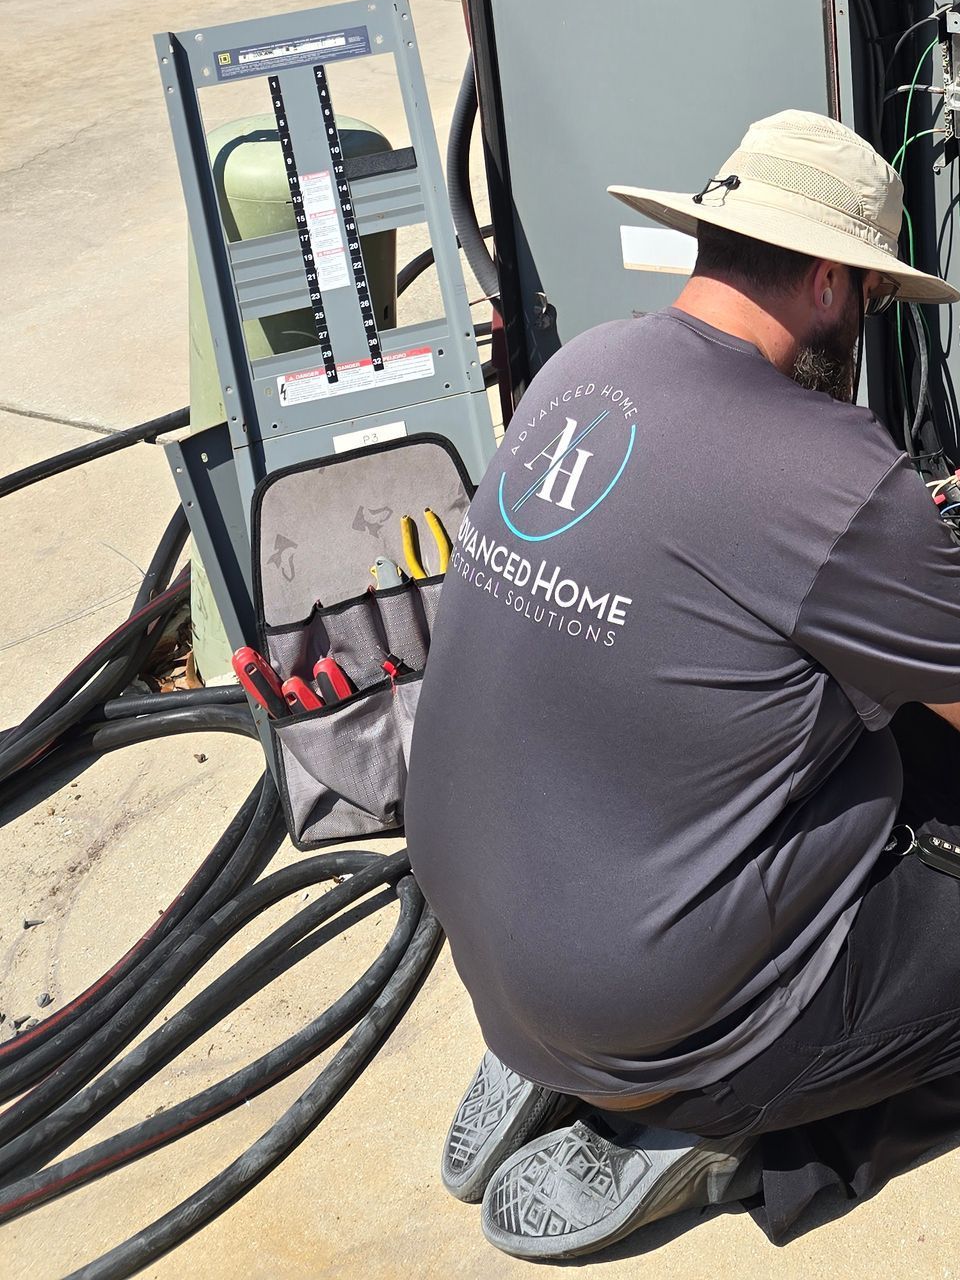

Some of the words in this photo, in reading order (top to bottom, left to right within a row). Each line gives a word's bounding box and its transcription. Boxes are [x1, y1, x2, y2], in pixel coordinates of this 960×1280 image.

[296, 371, 319, 379] DANGER
[337, 362, 360, 371] DANGER
[511, 384, 595, 456] ADVANCED
[601, 384, 637, 419] HOME
[363, 433, 379, 444] P3
[531, 560, 632, 626] HOME
[506, 590, 616, 646] SOLUTIONS
